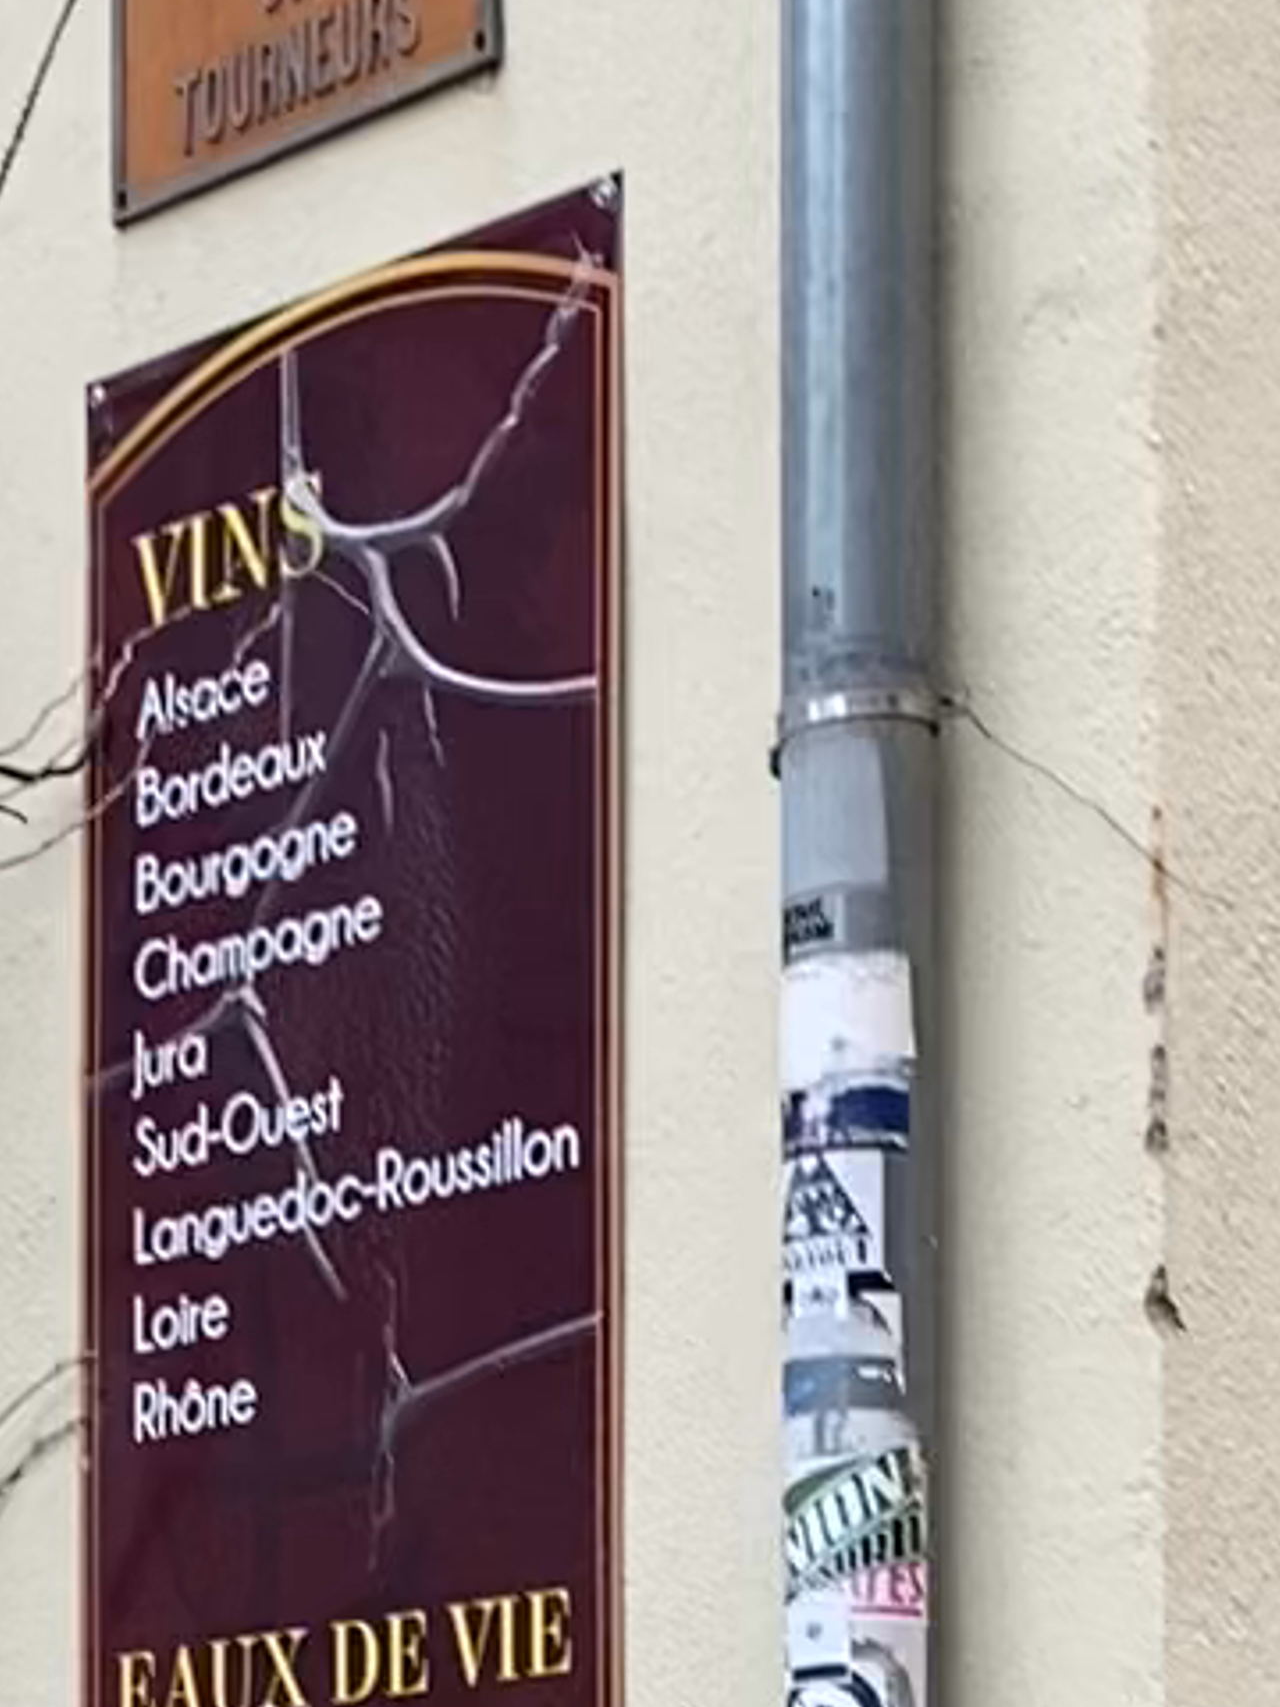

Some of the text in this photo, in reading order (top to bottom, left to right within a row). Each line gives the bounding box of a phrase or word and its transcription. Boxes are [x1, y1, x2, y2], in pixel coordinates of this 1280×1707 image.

[131, 483, 324, 627] VINS
[136, 656, 271, 741] Alsace
[136, 731, 328, 827] Bordeaux
[135, 810, 359, 915] Bourgogne
[134, 896, 384, 1001] Champagne
[131, 1029, 208, 1101] Jura
[132, 1076, 345, 1178] Sud-Ouest
[133, 1117, 581, 1266] Languedoc-Roussillon
[133, 1293, 230, 1354] Loire
[133, 1377, 257, 1444] Rhône
[330, 1608, 430, 1707] DE
[446, 1586, 574, 1688] VIE
